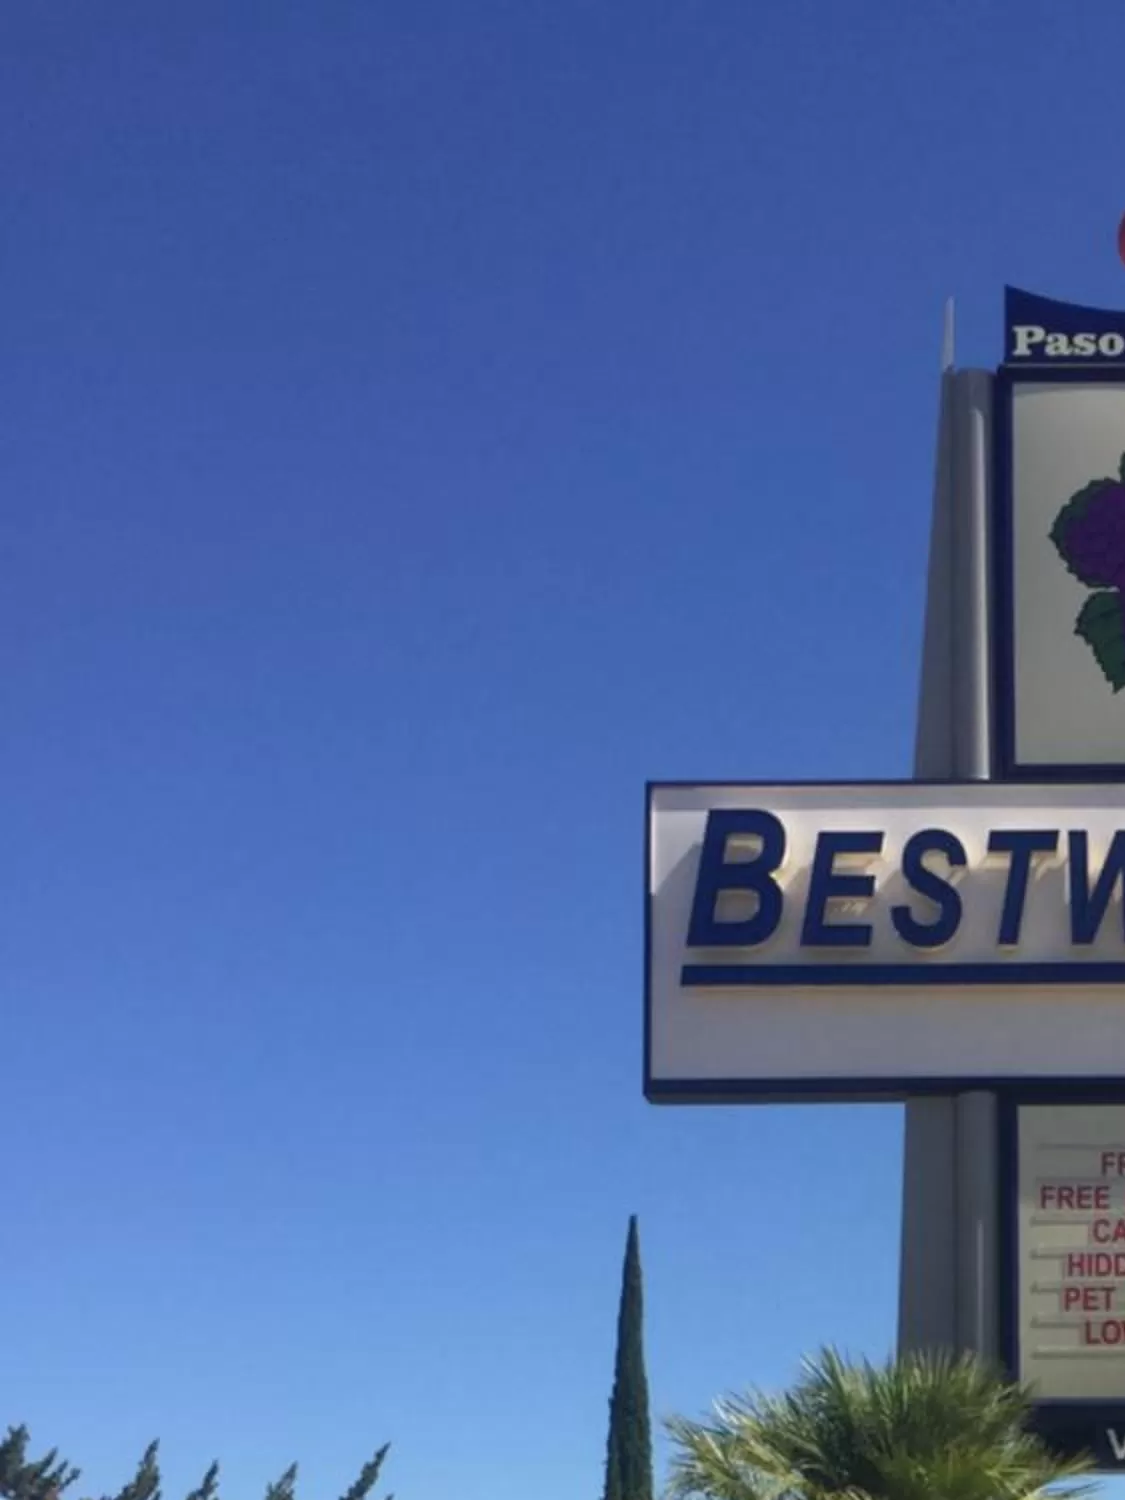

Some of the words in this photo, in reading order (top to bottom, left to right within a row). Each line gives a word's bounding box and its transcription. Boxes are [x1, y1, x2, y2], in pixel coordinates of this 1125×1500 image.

[1012, 325, 1125, 357] Paso
[1040, 1186, 1110, 1210] FREE
[1064, 1287, 1116, 1311] PET
